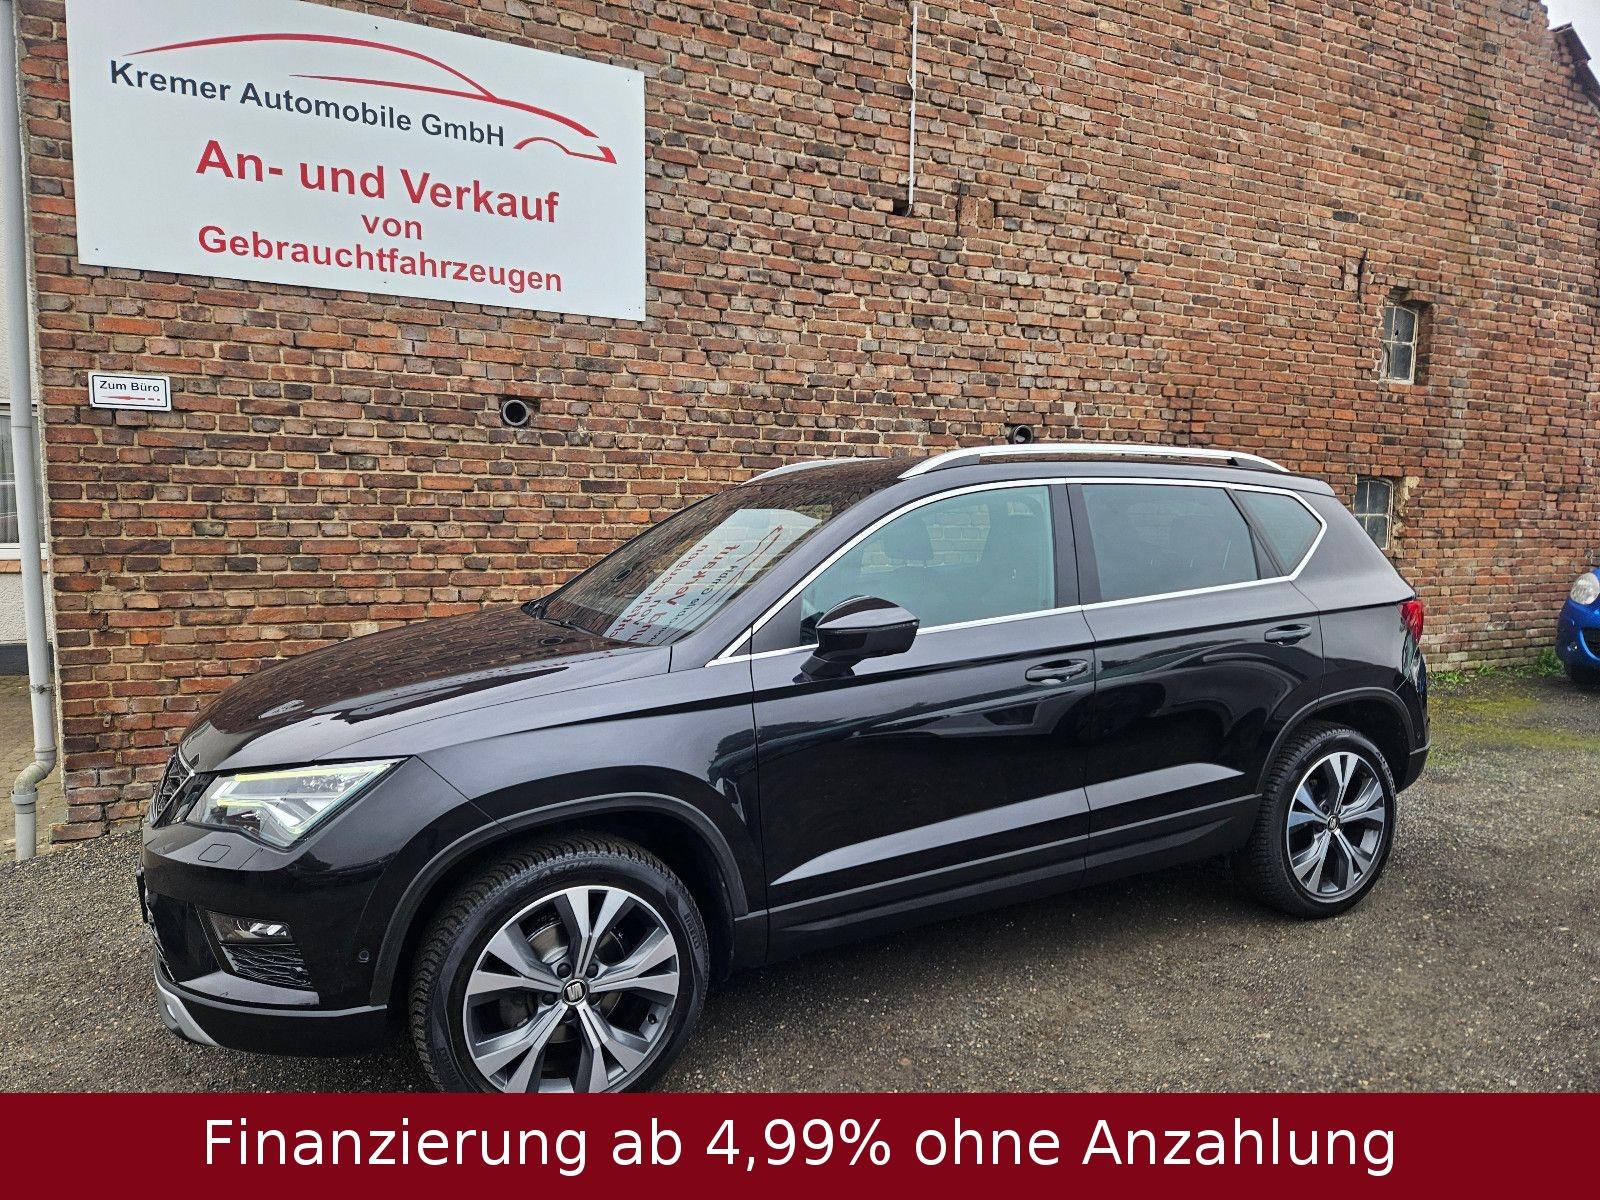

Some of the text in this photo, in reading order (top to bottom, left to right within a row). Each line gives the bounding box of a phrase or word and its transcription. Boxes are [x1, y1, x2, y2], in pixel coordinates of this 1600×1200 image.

[110, 60, 504, 147] Kremer Automobile GmbH
[196, 139, 560, 223] An- und Verkauf
[198, 224, 563, 293] Gebrauchtfahrzeugen
[361, 214, 423, 241] von
[99, 380, 160, 393] Zum Büro
